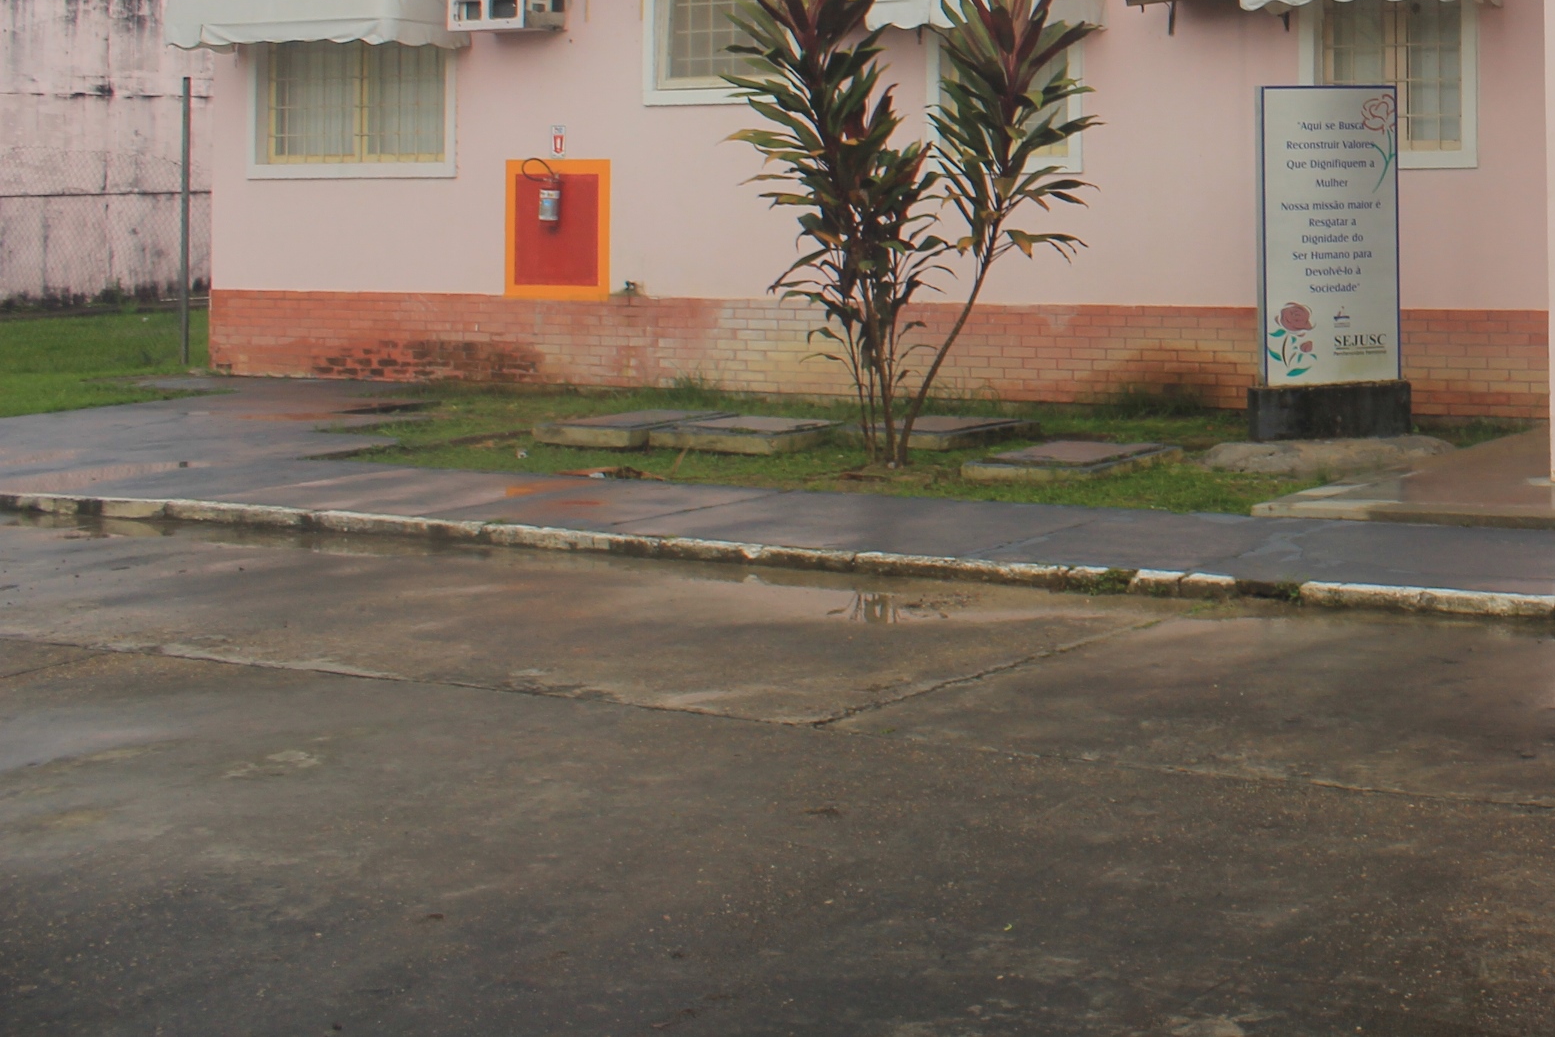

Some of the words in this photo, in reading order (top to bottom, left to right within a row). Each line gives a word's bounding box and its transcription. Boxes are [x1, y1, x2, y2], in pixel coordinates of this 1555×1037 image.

[1339, 121, 1365, 130] Busca
[1286, 141, 1340, 150] Reconstruir
[1342, 140, 1375, 149] Valores
[1286, 160, 1307, 170] Que
[1310, 158, 1366, 170] Dignifiquem
[1315, 178, 1348, 188] Mulher
[1281, 202, 1310, 211] Nossa
[1312, 200, 1345, 210] missão
[1348, 200, 1373, 209] maior
[1308, 218, 1348, 228] Resgatar
[1301, 234, 1349, 245] Dignidade
[1352, 233, 1364, 242] do
[1292, 251, 1308, 260] Ser
[1311, 250, 1350, 260] Humano
[1353, 250, 1372, 260] para
[1334, 333, 1387, 347] SEJUSC
